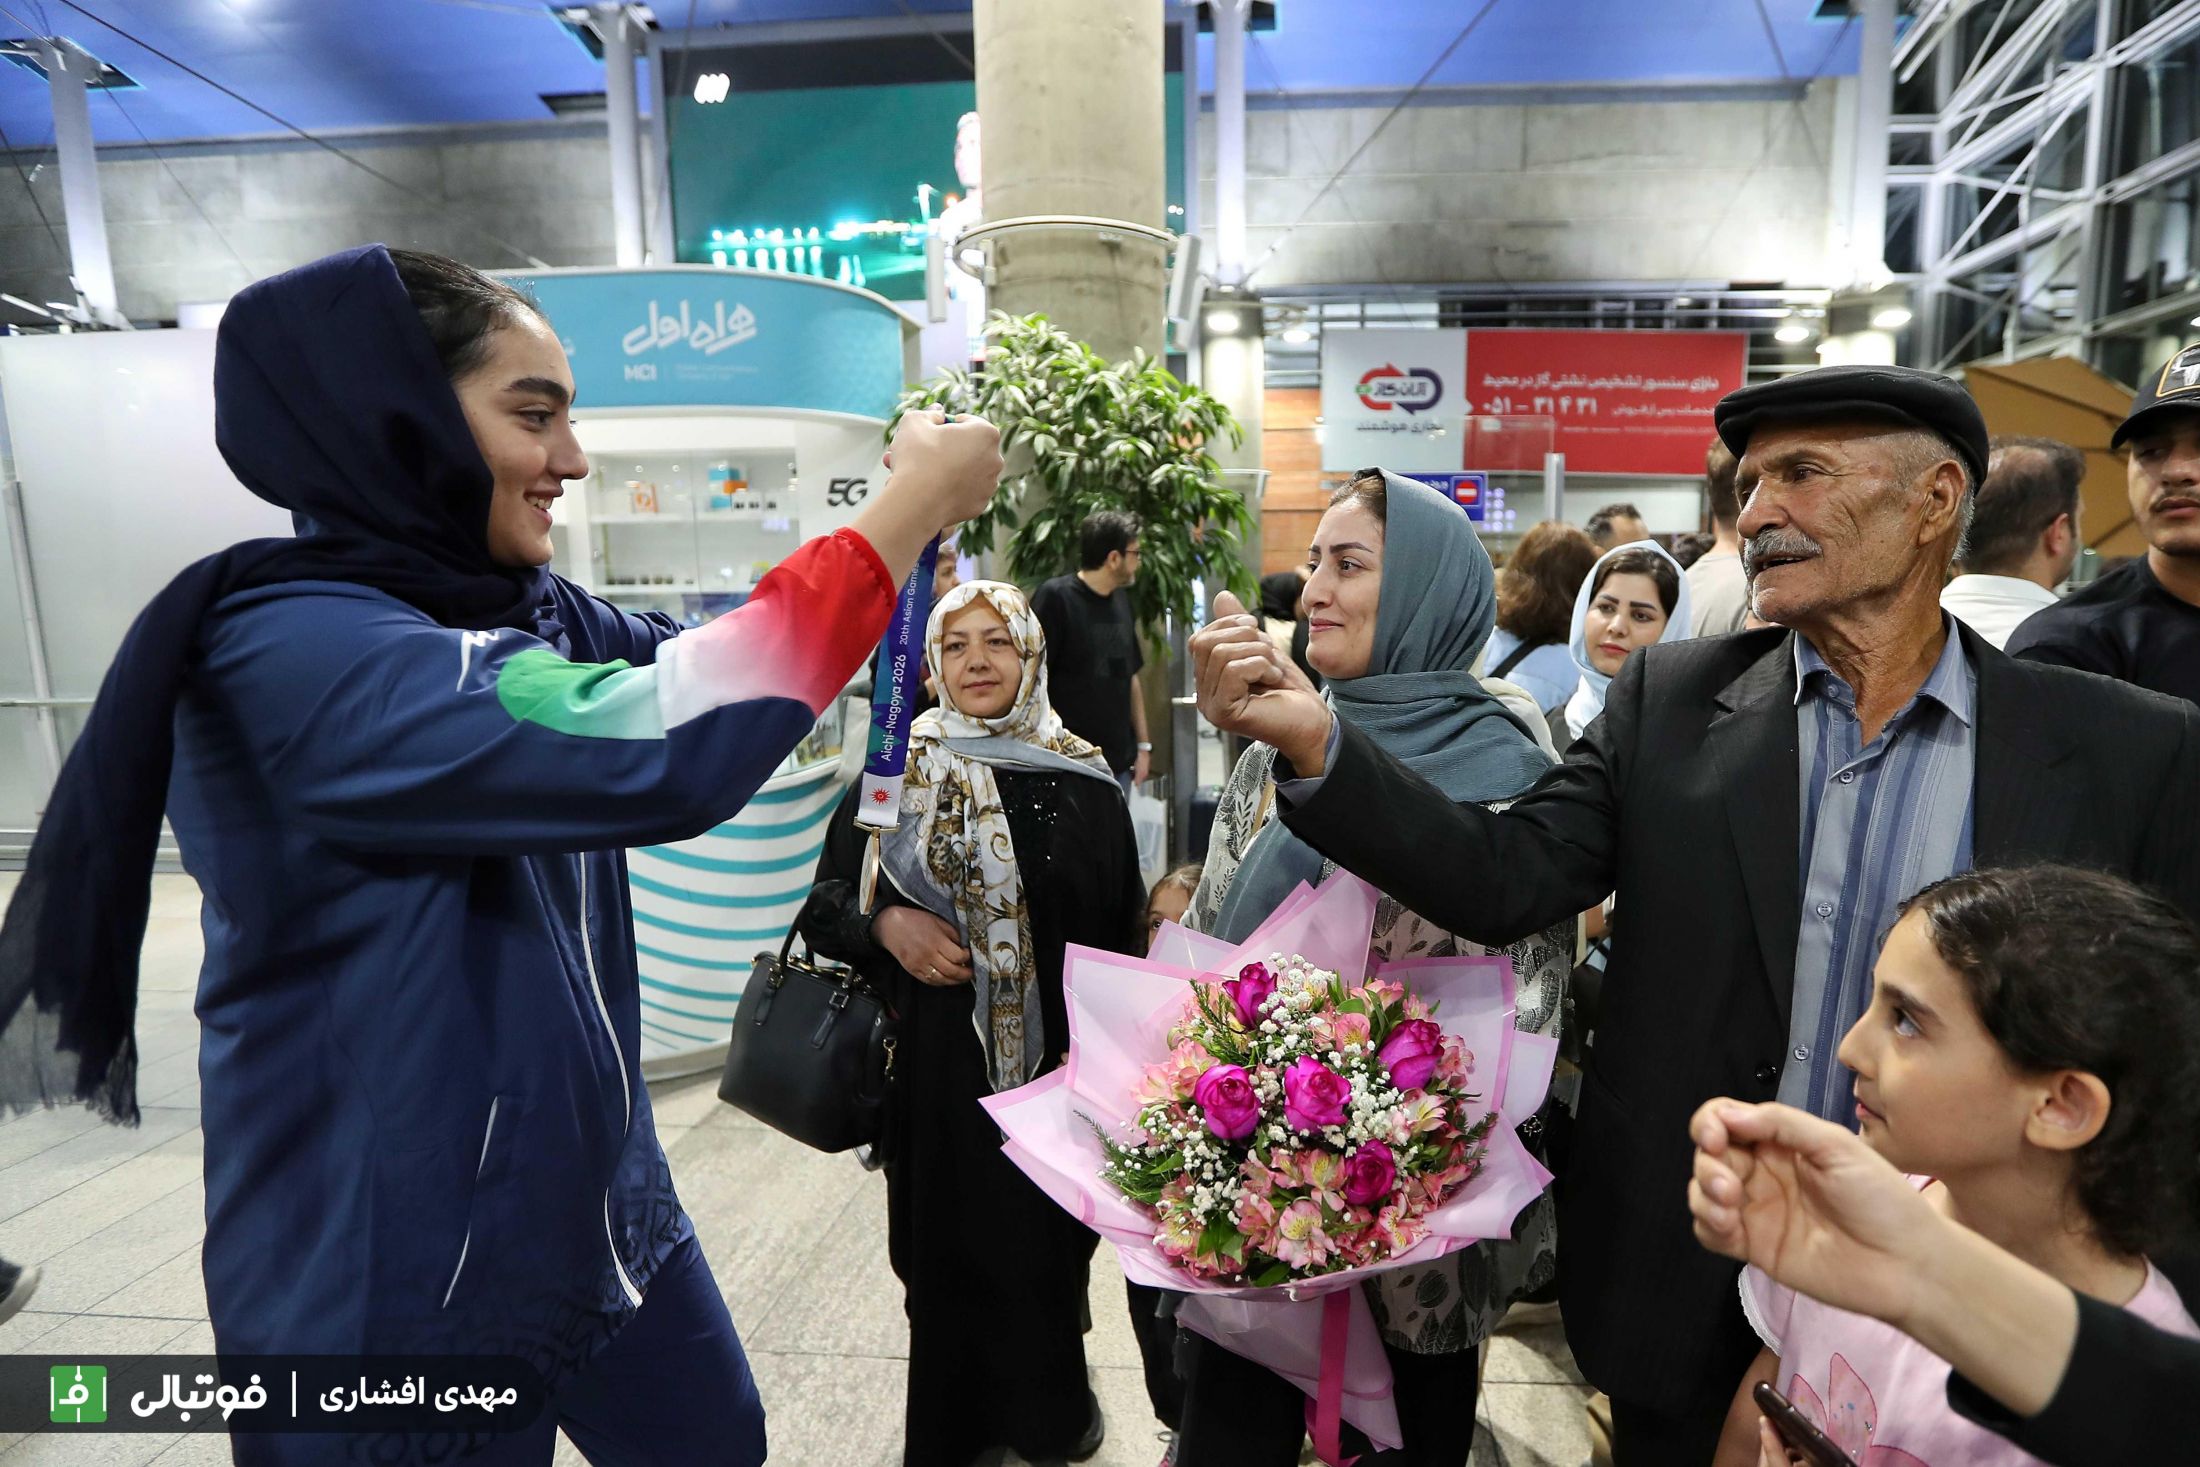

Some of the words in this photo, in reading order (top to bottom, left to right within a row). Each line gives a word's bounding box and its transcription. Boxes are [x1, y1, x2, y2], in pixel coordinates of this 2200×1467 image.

[622, 299, 691, 356] اول
[624, 364, 657, 381] MCI
[1482, 372, 1519, 389] محیط
[1534, 371, 1552, 390] گاز
[1519, 375, 1535, 390] در
[1551, 373, 1588, 391] نشتی
[1587, 373, 1642, 391] تشخیص
[1641, 375, 1689, 392] سنسور
[1357, 420, 1407, 434] هوشمند
[827, 477, 868, 507] 5G
[903, 597, 915, 623] Asian
[899, 624, 910, 646] 20th
[881, 686, 904, 762] Aichi-Nagoya
[893, 654, 907, 683] 2026
